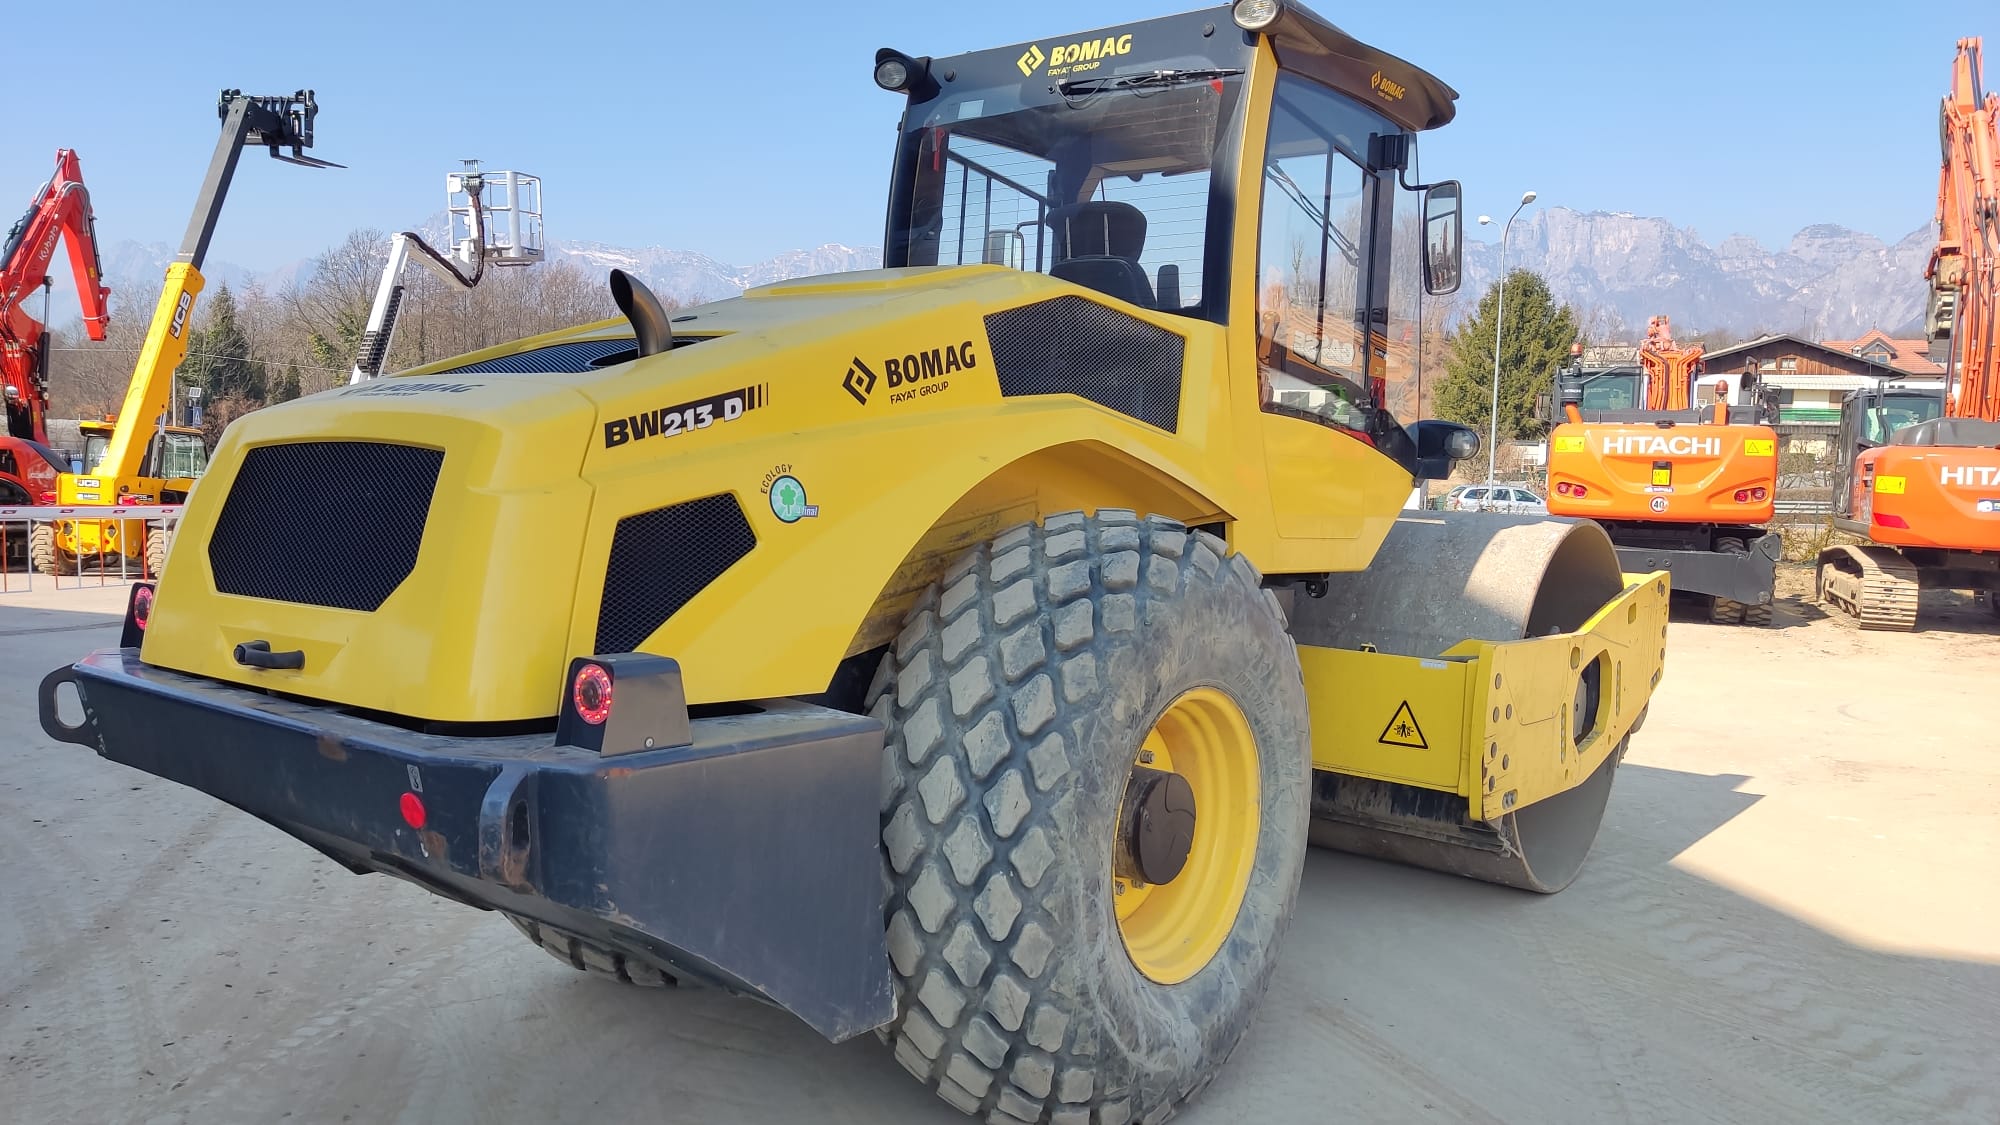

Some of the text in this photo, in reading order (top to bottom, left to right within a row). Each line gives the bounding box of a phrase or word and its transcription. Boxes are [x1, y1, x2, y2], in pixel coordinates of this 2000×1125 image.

[1049, 34, 1132, 67] BOMAG
[1072, 61, 1100, 74] GROUP
[1379, 77, 1406, 100] BOMAG
[169, 290, 193, 339] JCB
[884, 340, 976, 388] BOMAG
[889, 380, 950, 405] FAYAT GROUP
[1602, 436, 1722, 456] HITACHI
[760, 463, 793, 495] ECOLOGY
